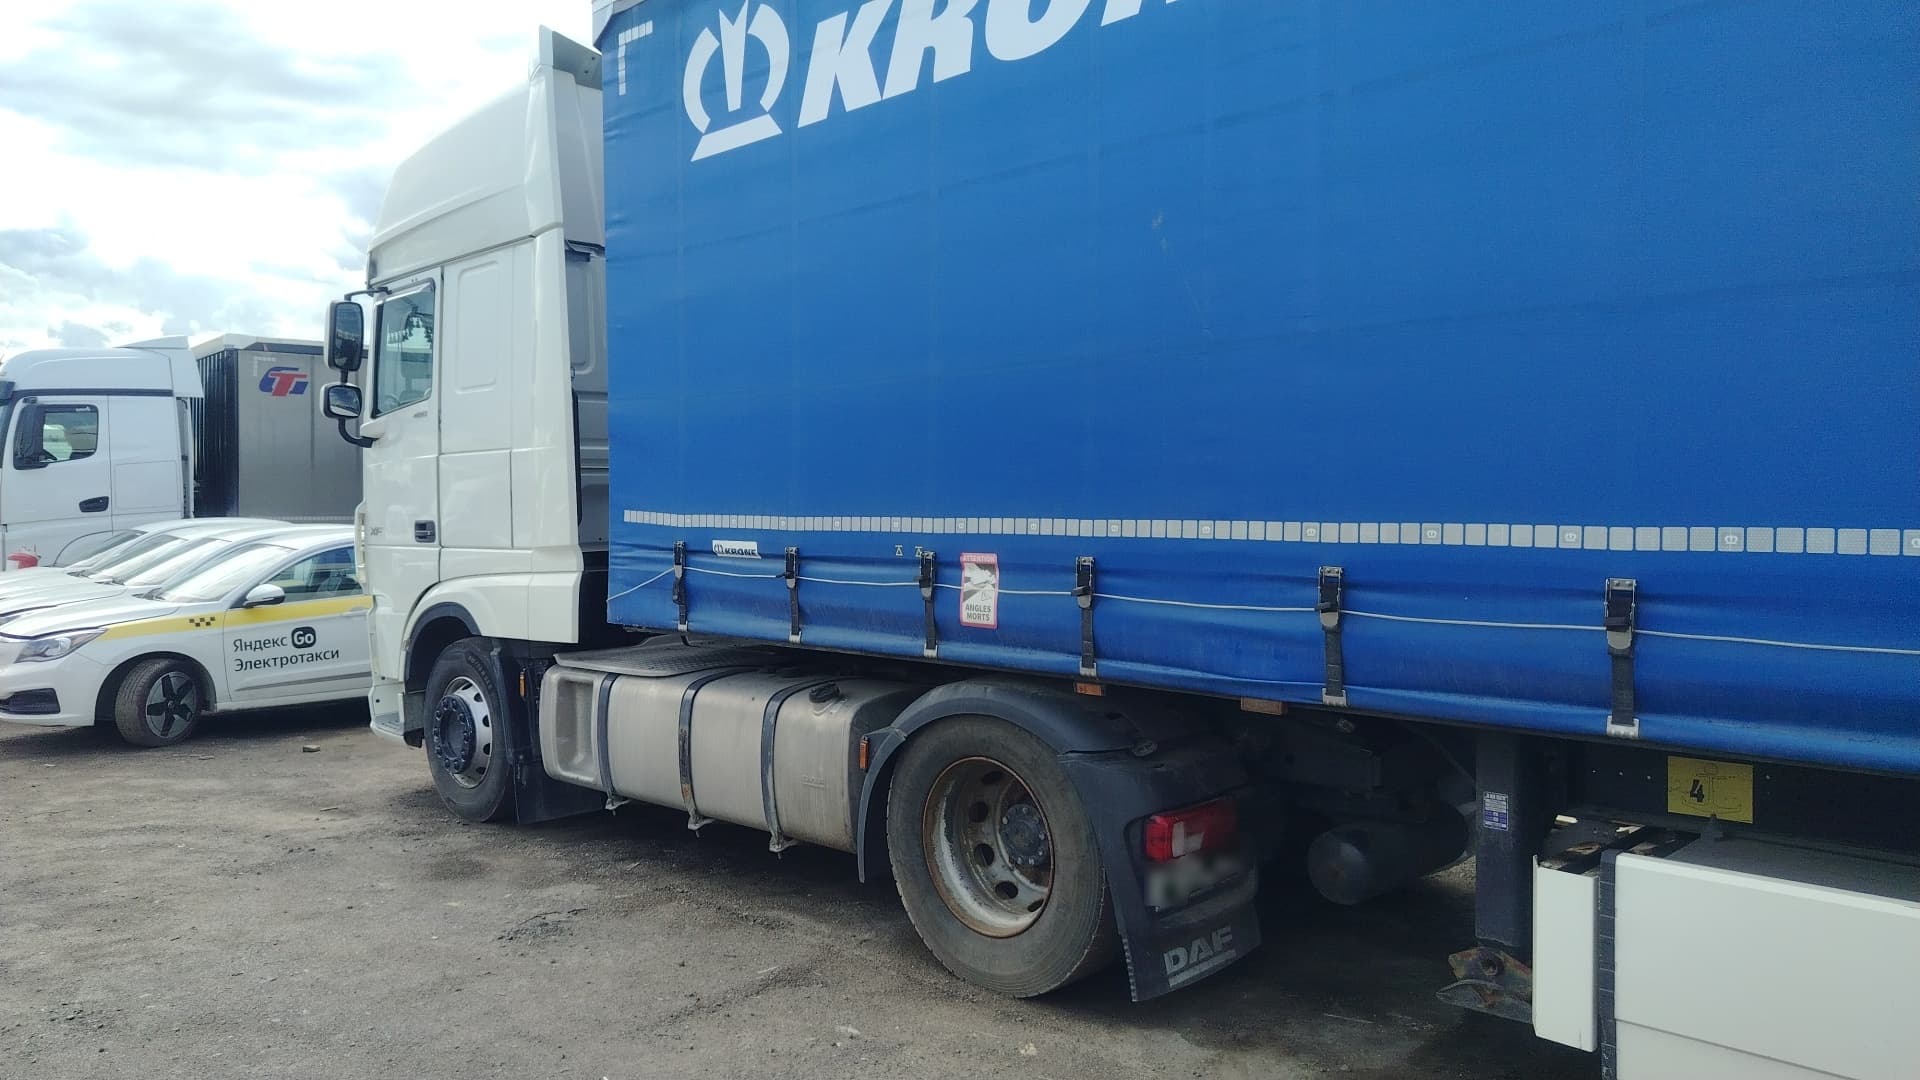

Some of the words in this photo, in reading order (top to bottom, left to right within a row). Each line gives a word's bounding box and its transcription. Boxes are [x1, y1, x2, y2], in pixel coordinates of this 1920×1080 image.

[797, 0, 1177, 128] KRO
[965, 602, 991, 612] ANGLES
[966, 612, 990, 621] MORTS
[233, 636, 288, 652] Яндекс
[293, 630, 315, 646] Go
[234, 649, 339, 671] Электротакси
[1690, 779, 1704, 802] 4
[1163, 924, 1233, 975] DAF
